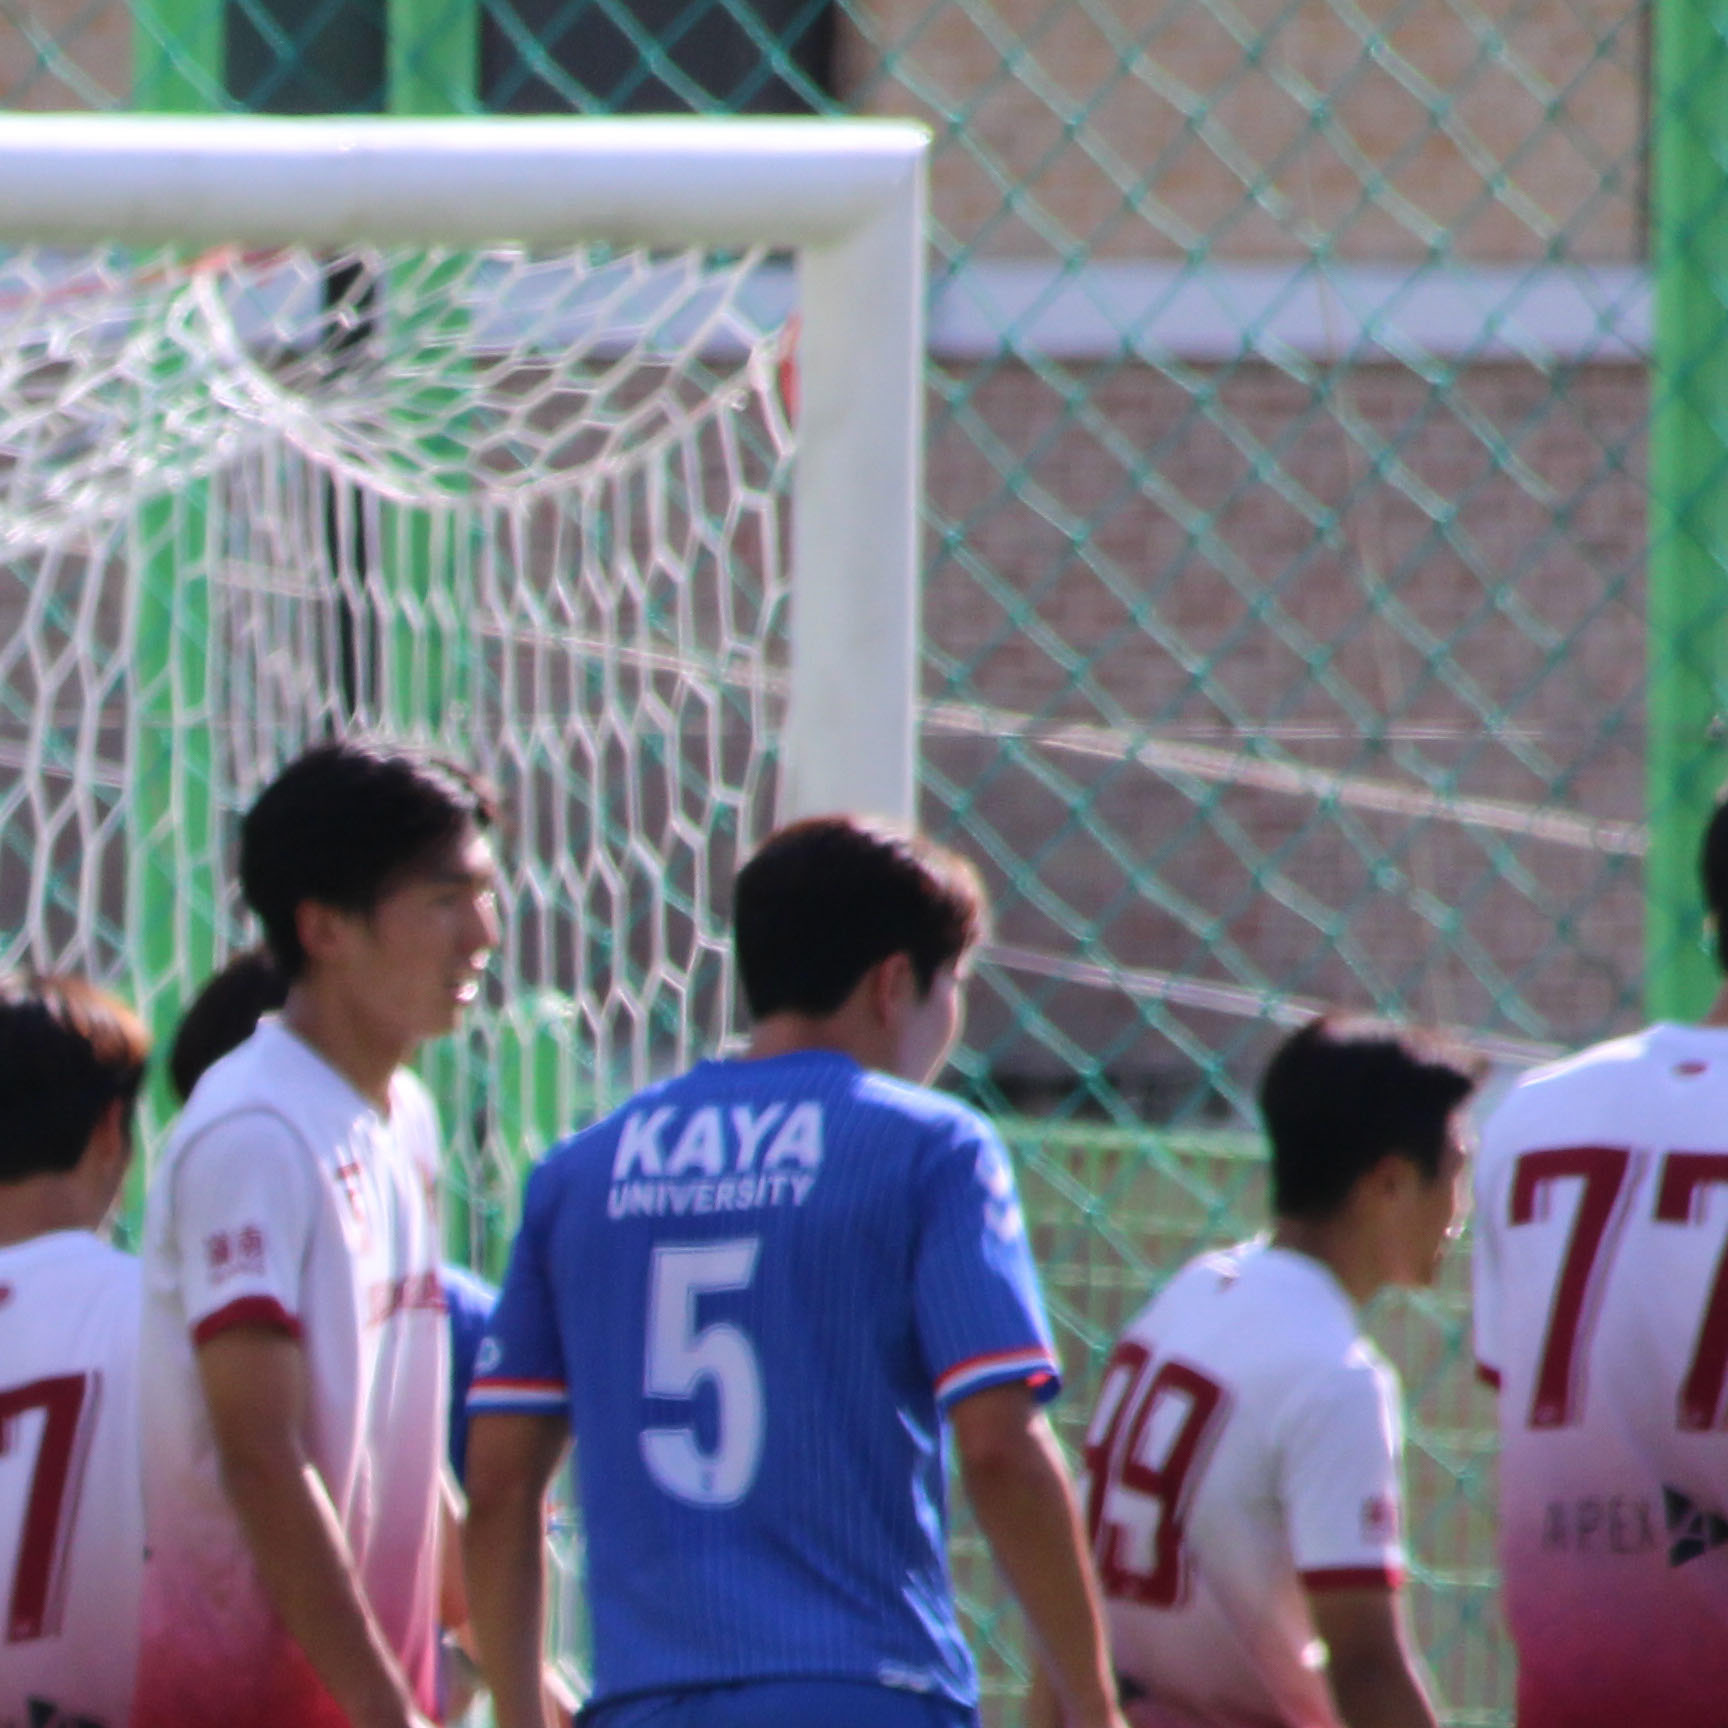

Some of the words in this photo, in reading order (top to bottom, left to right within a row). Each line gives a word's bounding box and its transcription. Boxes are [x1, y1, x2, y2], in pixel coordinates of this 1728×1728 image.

[613, 1098, 825, 1183] KAYA
[607, 1170, 819, 1222] UNIVERSITY
[639, 1236, 768, 1511] 5
